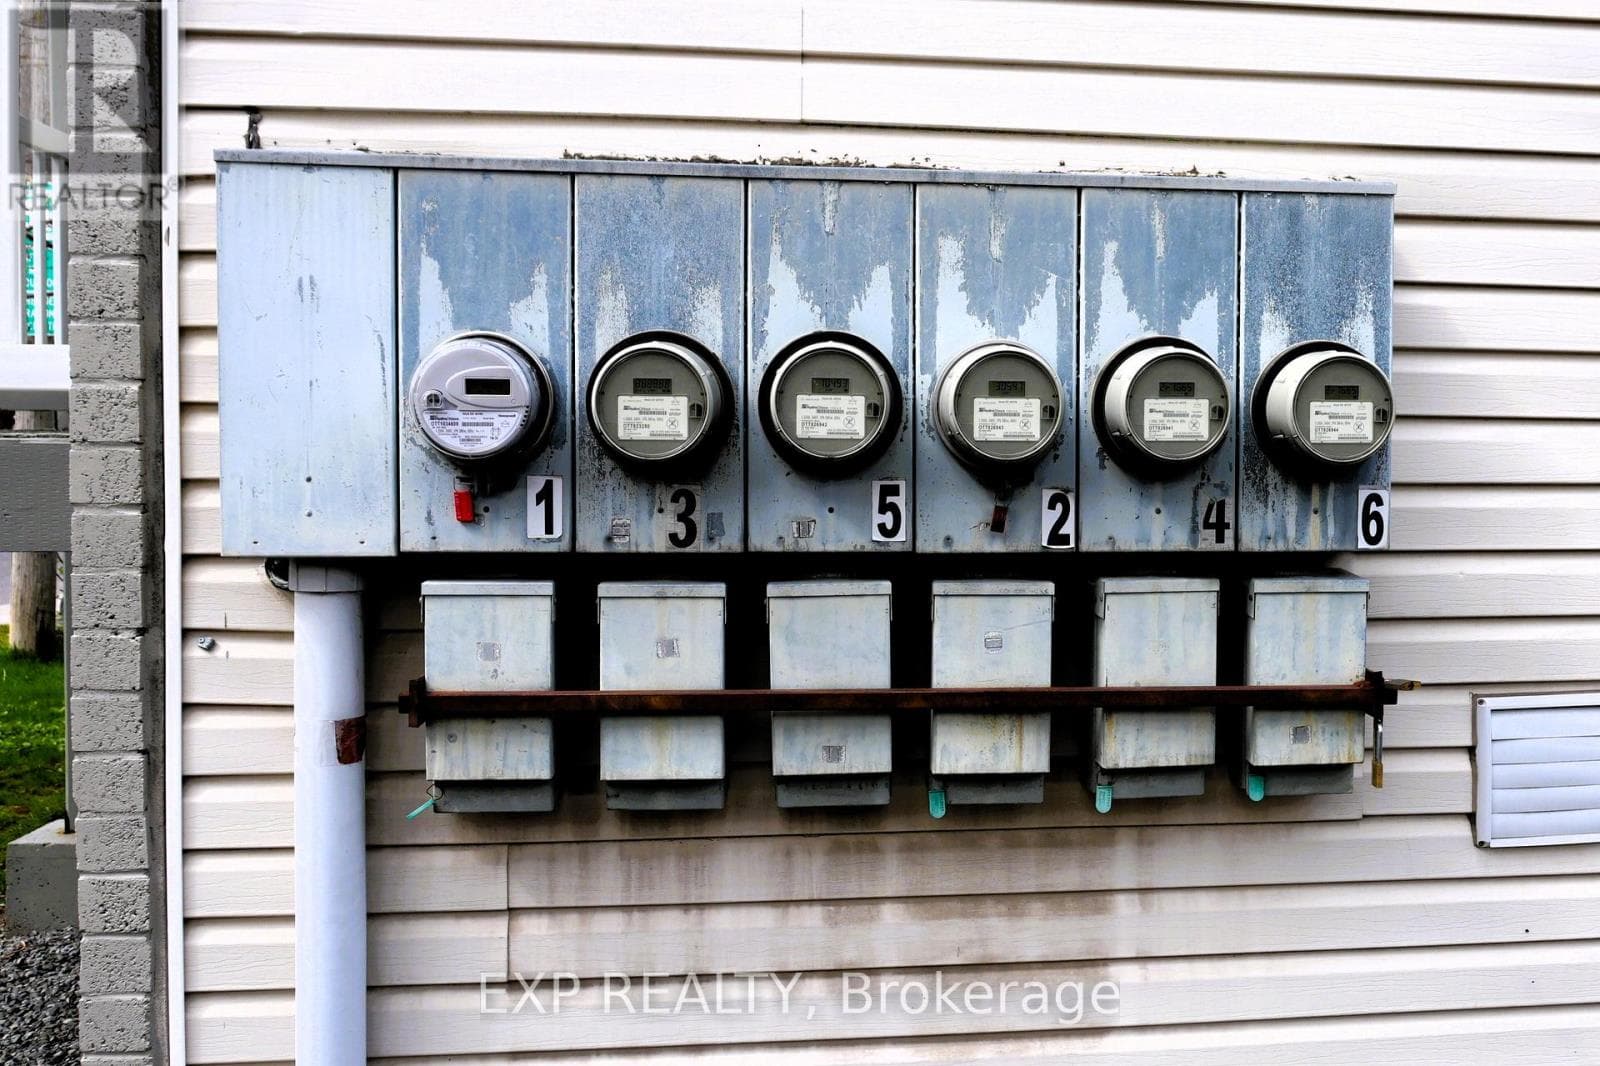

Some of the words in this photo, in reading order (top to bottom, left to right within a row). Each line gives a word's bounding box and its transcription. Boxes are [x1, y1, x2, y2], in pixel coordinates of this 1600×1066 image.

[535, 479, 554, 536] 1
[668, 488, 698, 549] 3
[877, 484, 902, 540] 5
[1046, 492, 1072, 547] 2
[1202, 498, 1231, 544] 4
[1361, 493, 1385, 546] 6
